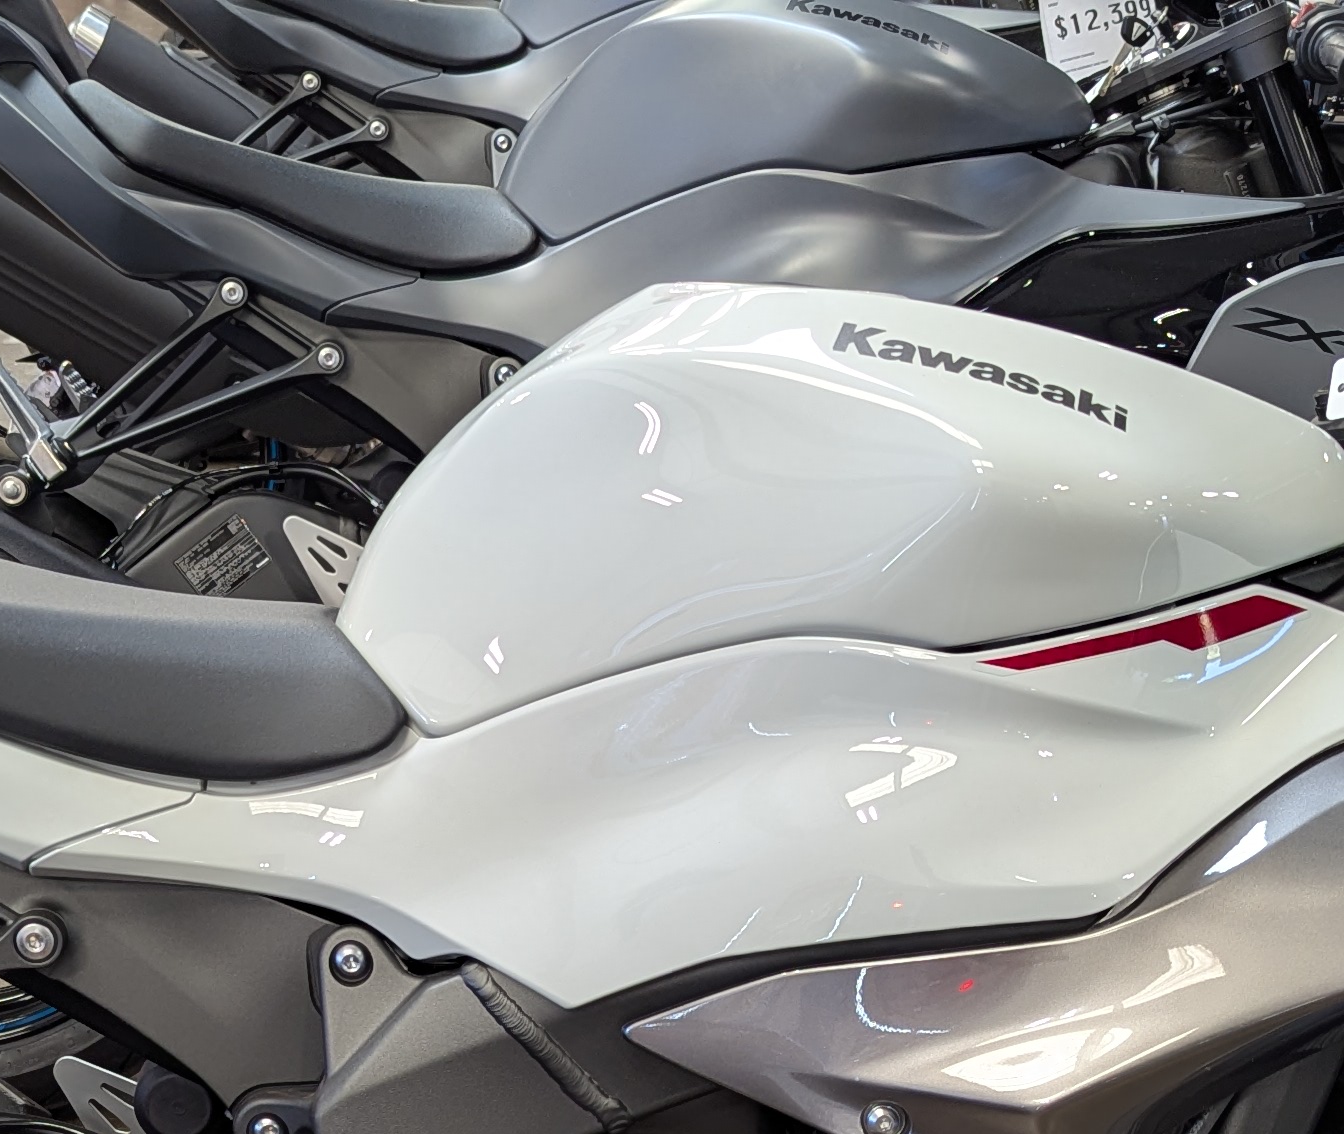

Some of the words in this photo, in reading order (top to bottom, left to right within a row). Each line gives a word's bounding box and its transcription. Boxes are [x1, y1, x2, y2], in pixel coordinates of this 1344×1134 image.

[786, 0, 950, 55] Kawasaki
[1055, 0, 1151, 40] $12,399
[832, 322, 1129, 433] Kawasaki
